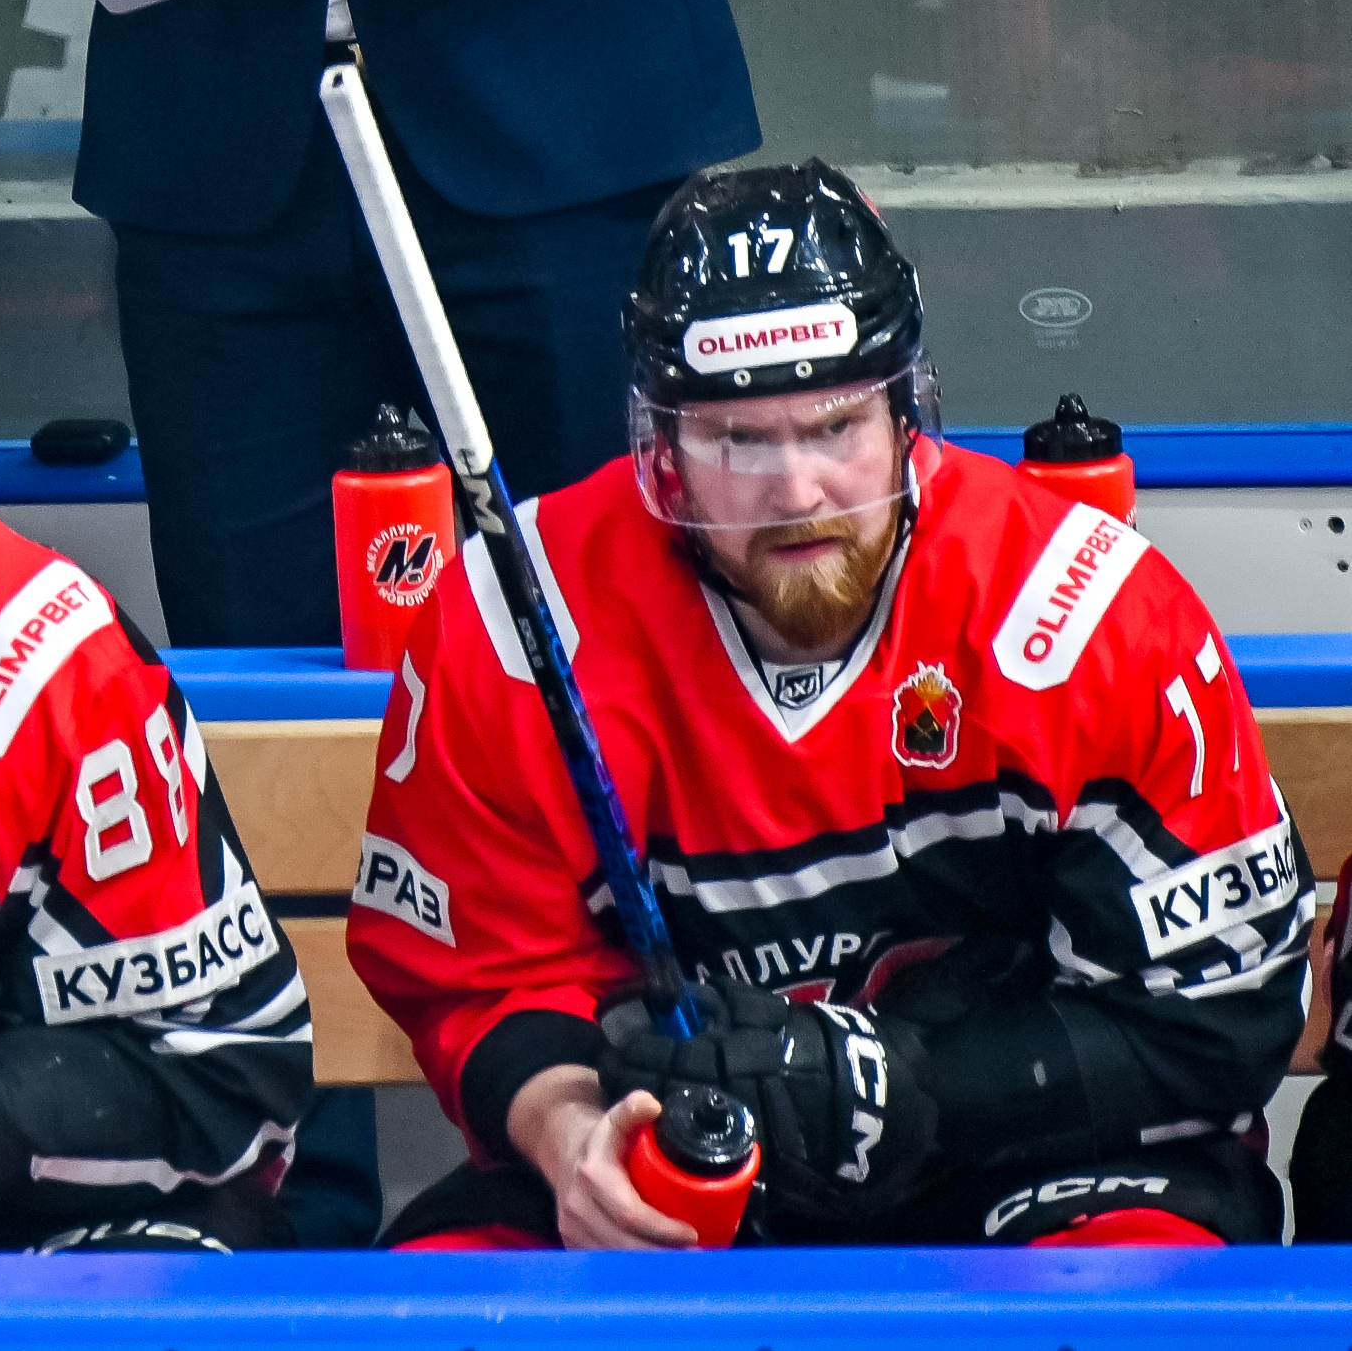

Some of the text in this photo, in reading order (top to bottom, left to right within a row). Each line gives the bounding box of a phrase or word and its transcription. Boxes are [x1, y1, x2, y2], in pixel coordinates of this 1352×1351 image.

[728, 227, 796, 277] 17
[697, 320, 845, 356] OLIMPBET
[1022, 517, 1125, 664] OLIMPBET
[75, 703, 190, 882] 88
[56, 904, 264, 1010] КУЗБАСС
[985, 1176, 1170, 1237] CCM
